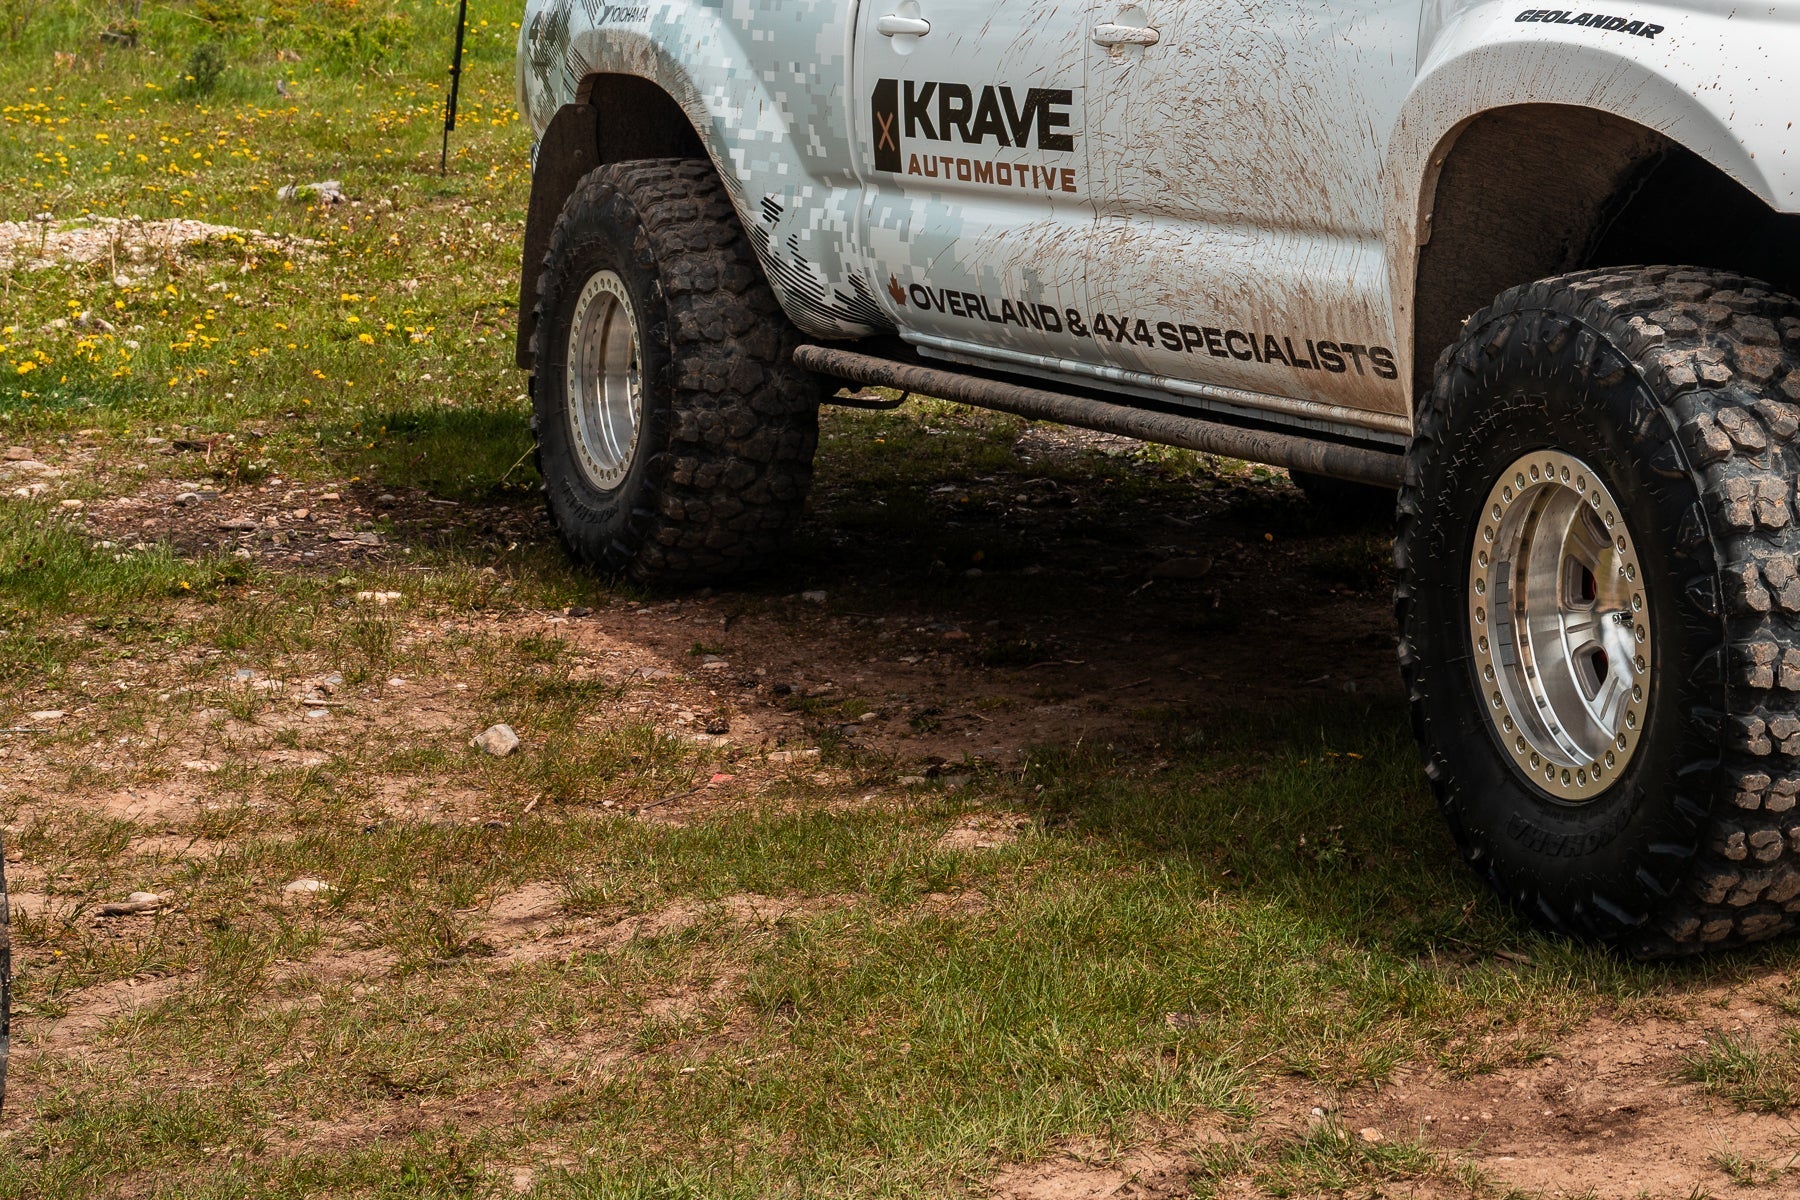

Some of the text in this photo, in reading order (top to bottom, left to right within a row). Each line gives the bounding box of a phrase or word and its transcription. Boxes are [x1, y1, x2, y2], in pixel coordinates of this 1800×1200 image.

[1514, 9, 1665, 40] GEOLANDAR
[903, 79, 1075, 152] KRAVE
[908, 153, 1077, 193] AUTOMOTIVE
[909, 283, 1398, 380] OVERLAND & 4X4 SPECIALISTS
